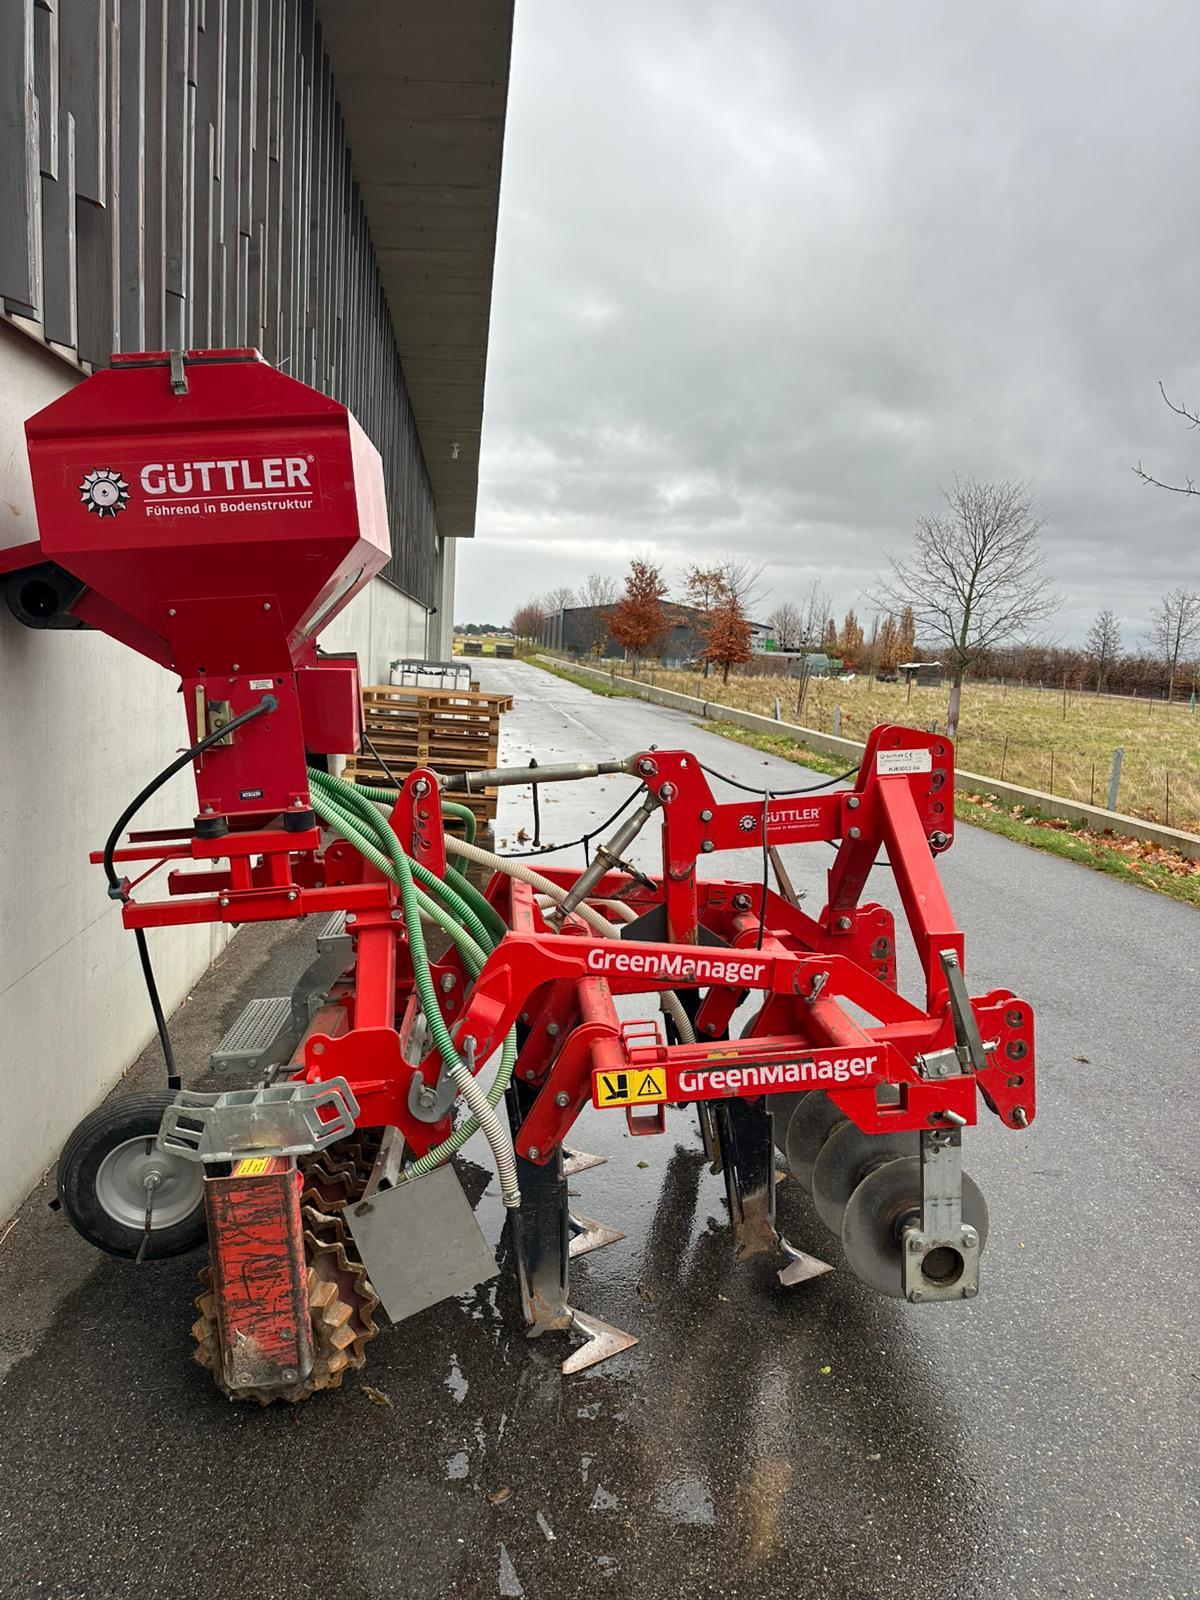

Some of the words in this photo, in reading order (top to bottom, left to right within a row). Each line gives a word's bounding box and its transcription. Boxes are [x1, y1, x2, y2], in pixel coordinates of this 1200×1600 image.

[146, 501, 200, 517] Führend
[203, 502, 216, 514] in
[220, 499, 313, 513] Bodenstruktur
[588, 948, 765, 983] GreenManager
[679, 1055, 878, 1093] GreenManager
